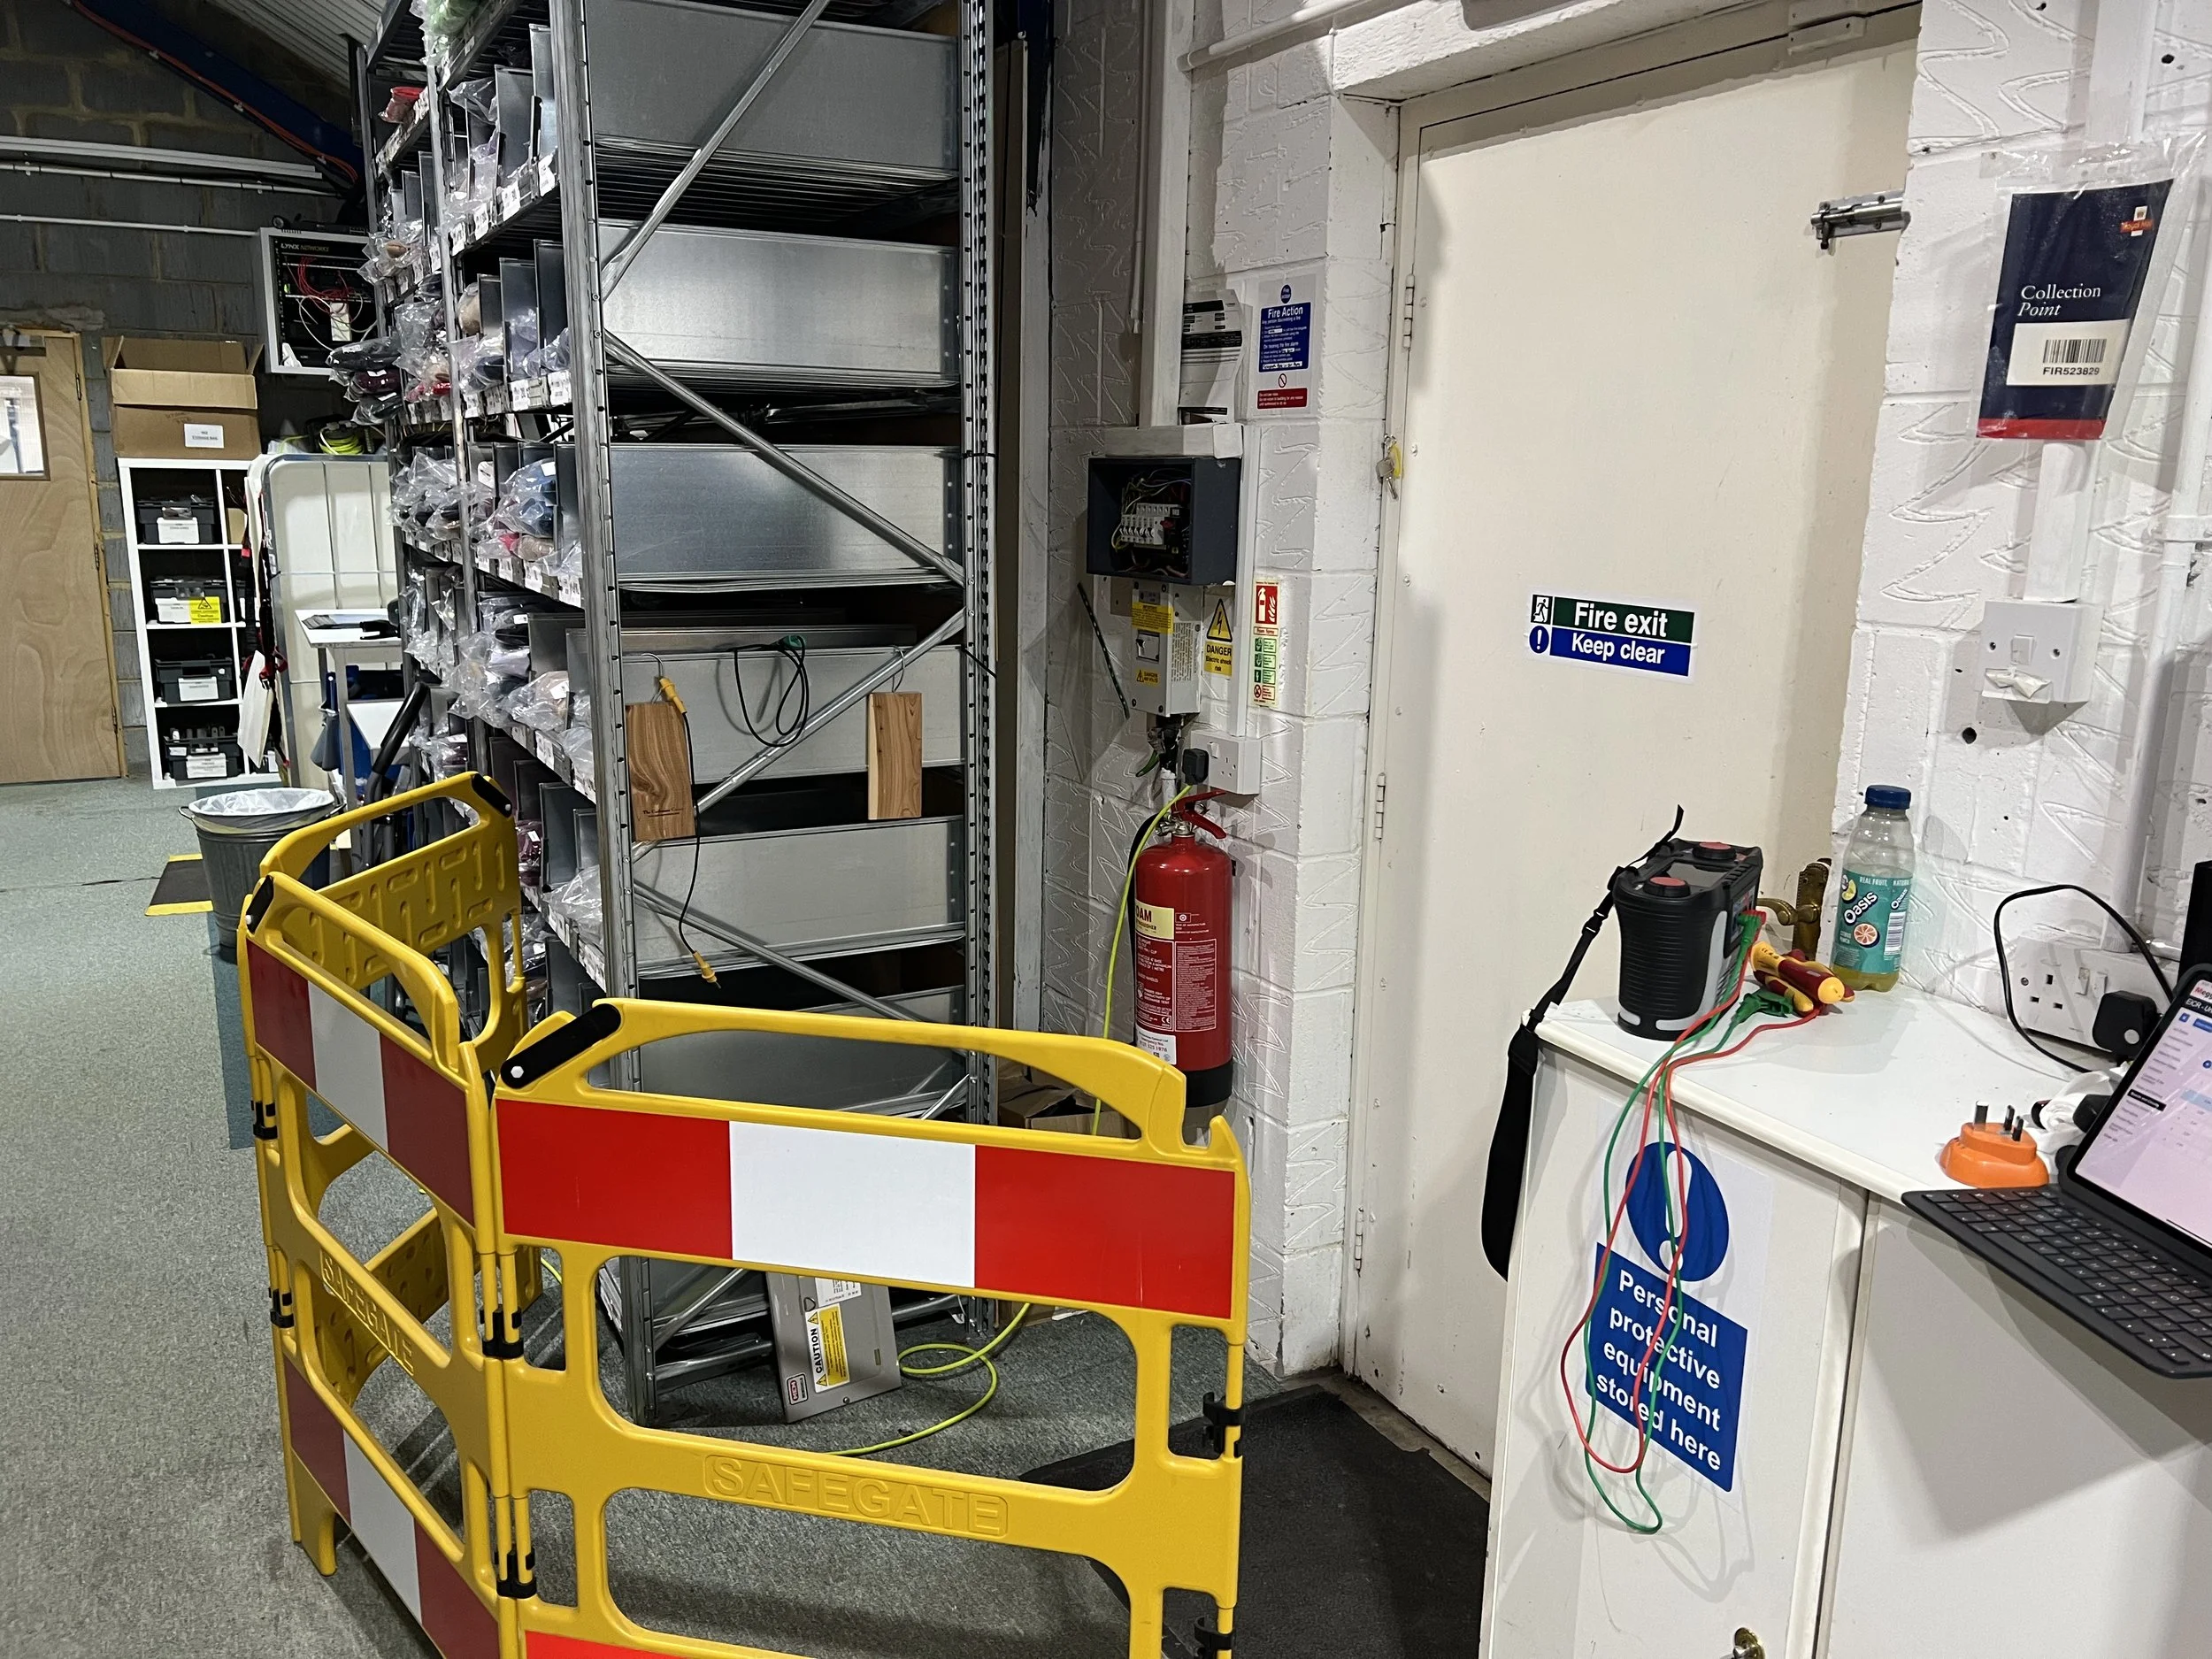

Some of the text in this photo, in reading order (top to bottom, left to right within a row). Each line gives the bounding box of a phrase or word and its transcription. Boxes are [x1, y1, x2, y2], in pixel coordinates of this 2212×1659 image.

[2020, 282, 2102, 301] Collection
[1268, 306, 1303, 319] Fire Action
[2017, 302, 2061, 317] Point
[2042, 366, 2101, 376] FIR523829
[1574, 602, 1668, 637] Fire exit
[1207, 645, 1232, 656] DANGER
[1571, 633, 1665, 664] Keep clear
[1136, 906, 1151, 922] OAM
[1844, 892, 1878, 924] Oasis
[2185, 999, 2201, 1009] EICR
[2195, 987, 2212, 1000] Megg
[323, 1256, 414, 1376] SAFEGATE
[1618, 1269, 1717, 1348] Personal
[811, 1328, 824, 1374] CAUTION
[1609, 1307, 1721, 1389] protective
[1603, 1341, 1721, 1432] equipment
[1671, 1418, 1721, 1471] here
[711, 1456, 1003, 1536] SAFEGATE
